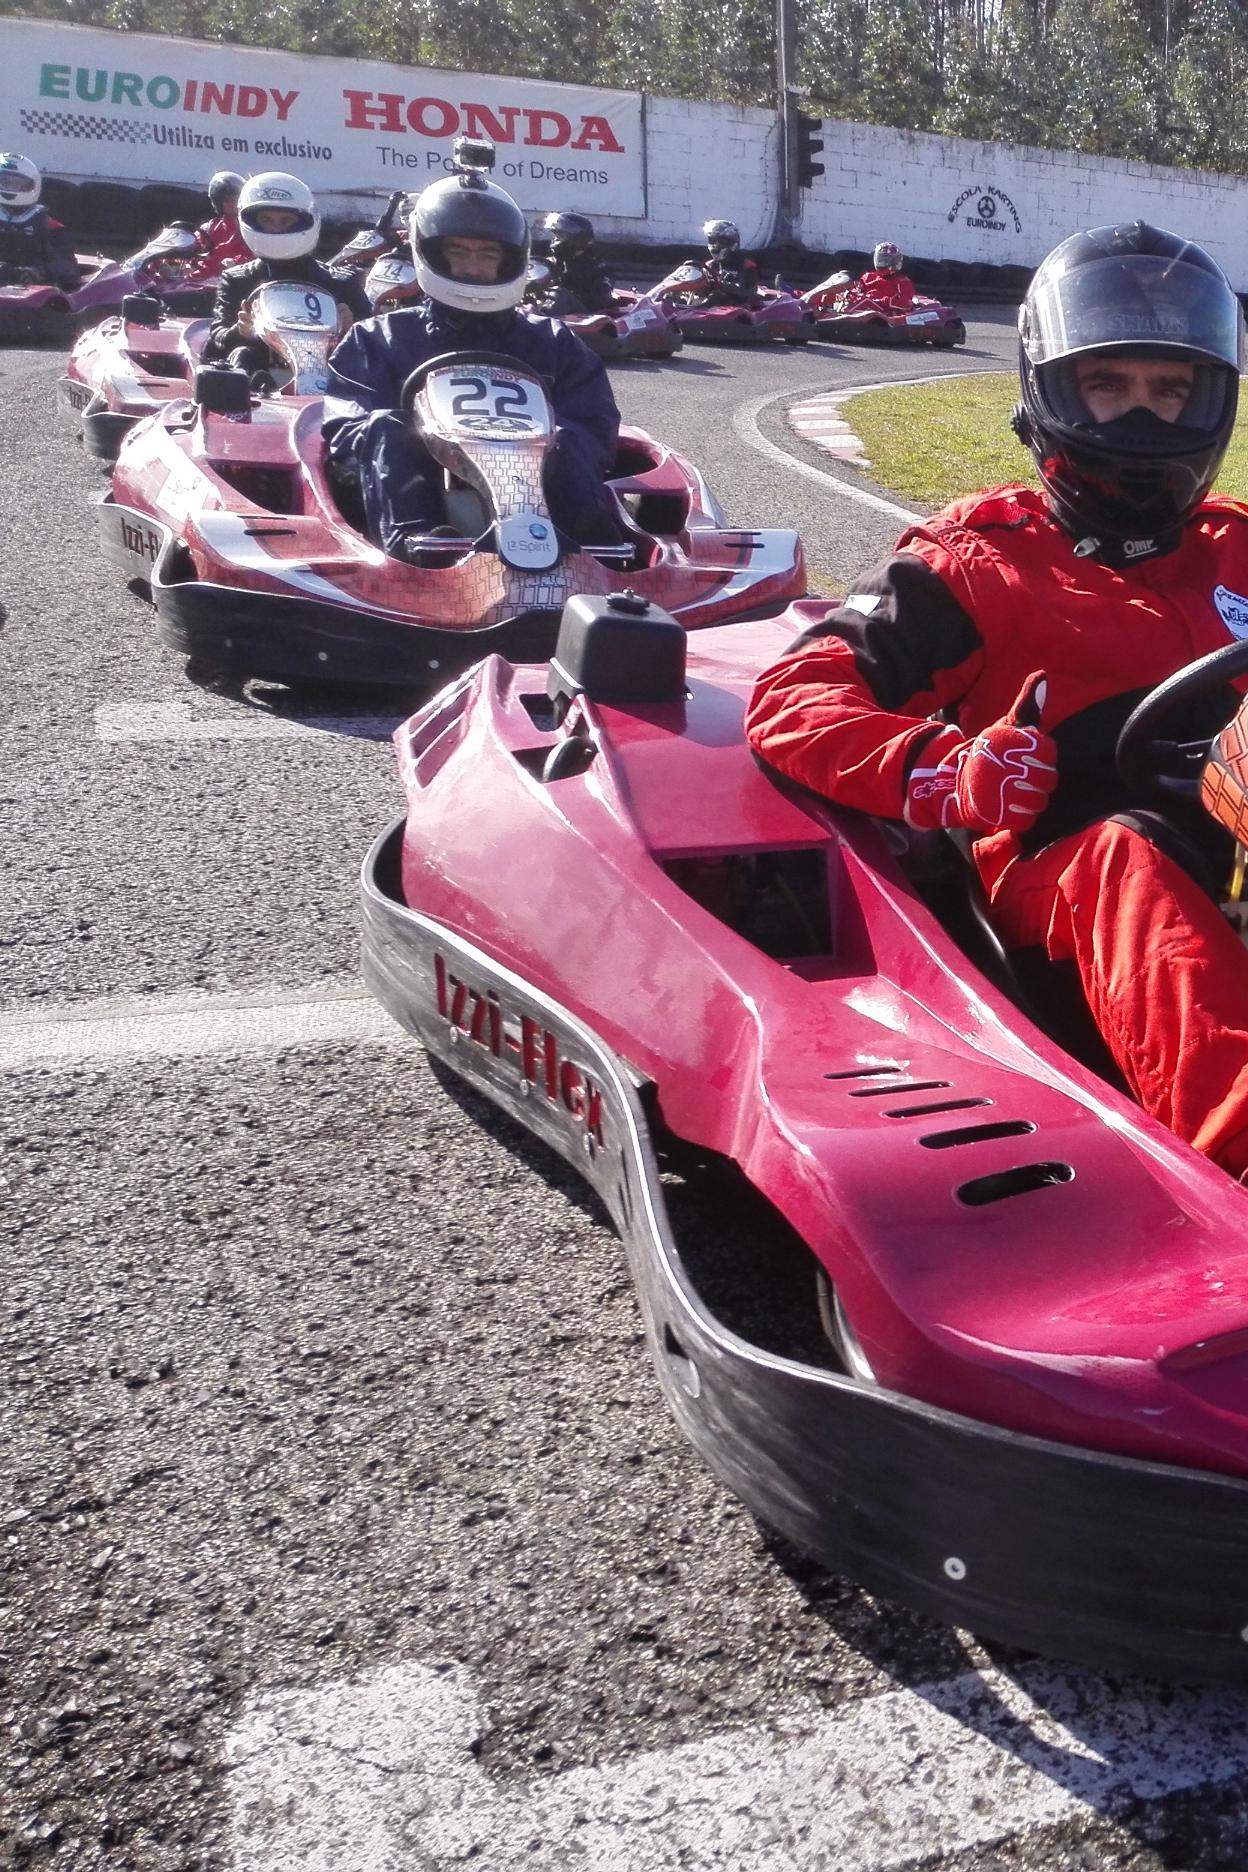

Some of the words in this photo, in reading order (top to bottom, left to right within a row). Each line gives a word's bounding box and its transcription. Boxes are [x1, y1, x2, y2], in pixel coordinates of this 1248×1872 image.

[39, 62, 300, 121] EUROINDY
[342, 89, 625, 153] HONDA
[153, 124, 215, 150] Utiliza
[221, 138, 249, 153] em
[255, 136, 333, 160] exclusivo
[376, 146, 418, 168] The
[427, 152, 493, 175] Por
[503, 160, 525, 177] of
[530, 161, 609, 184] Dreams
[947, 185, 982, 223] ESCOLA
[987, 185, 1022, 233] KARTING
[966, 217, 1007, 231] EUROINDY
[382, 262, 403, 280] 14
[304, 293, 322, 320] 9
[449, 377, 533, 421] 22
